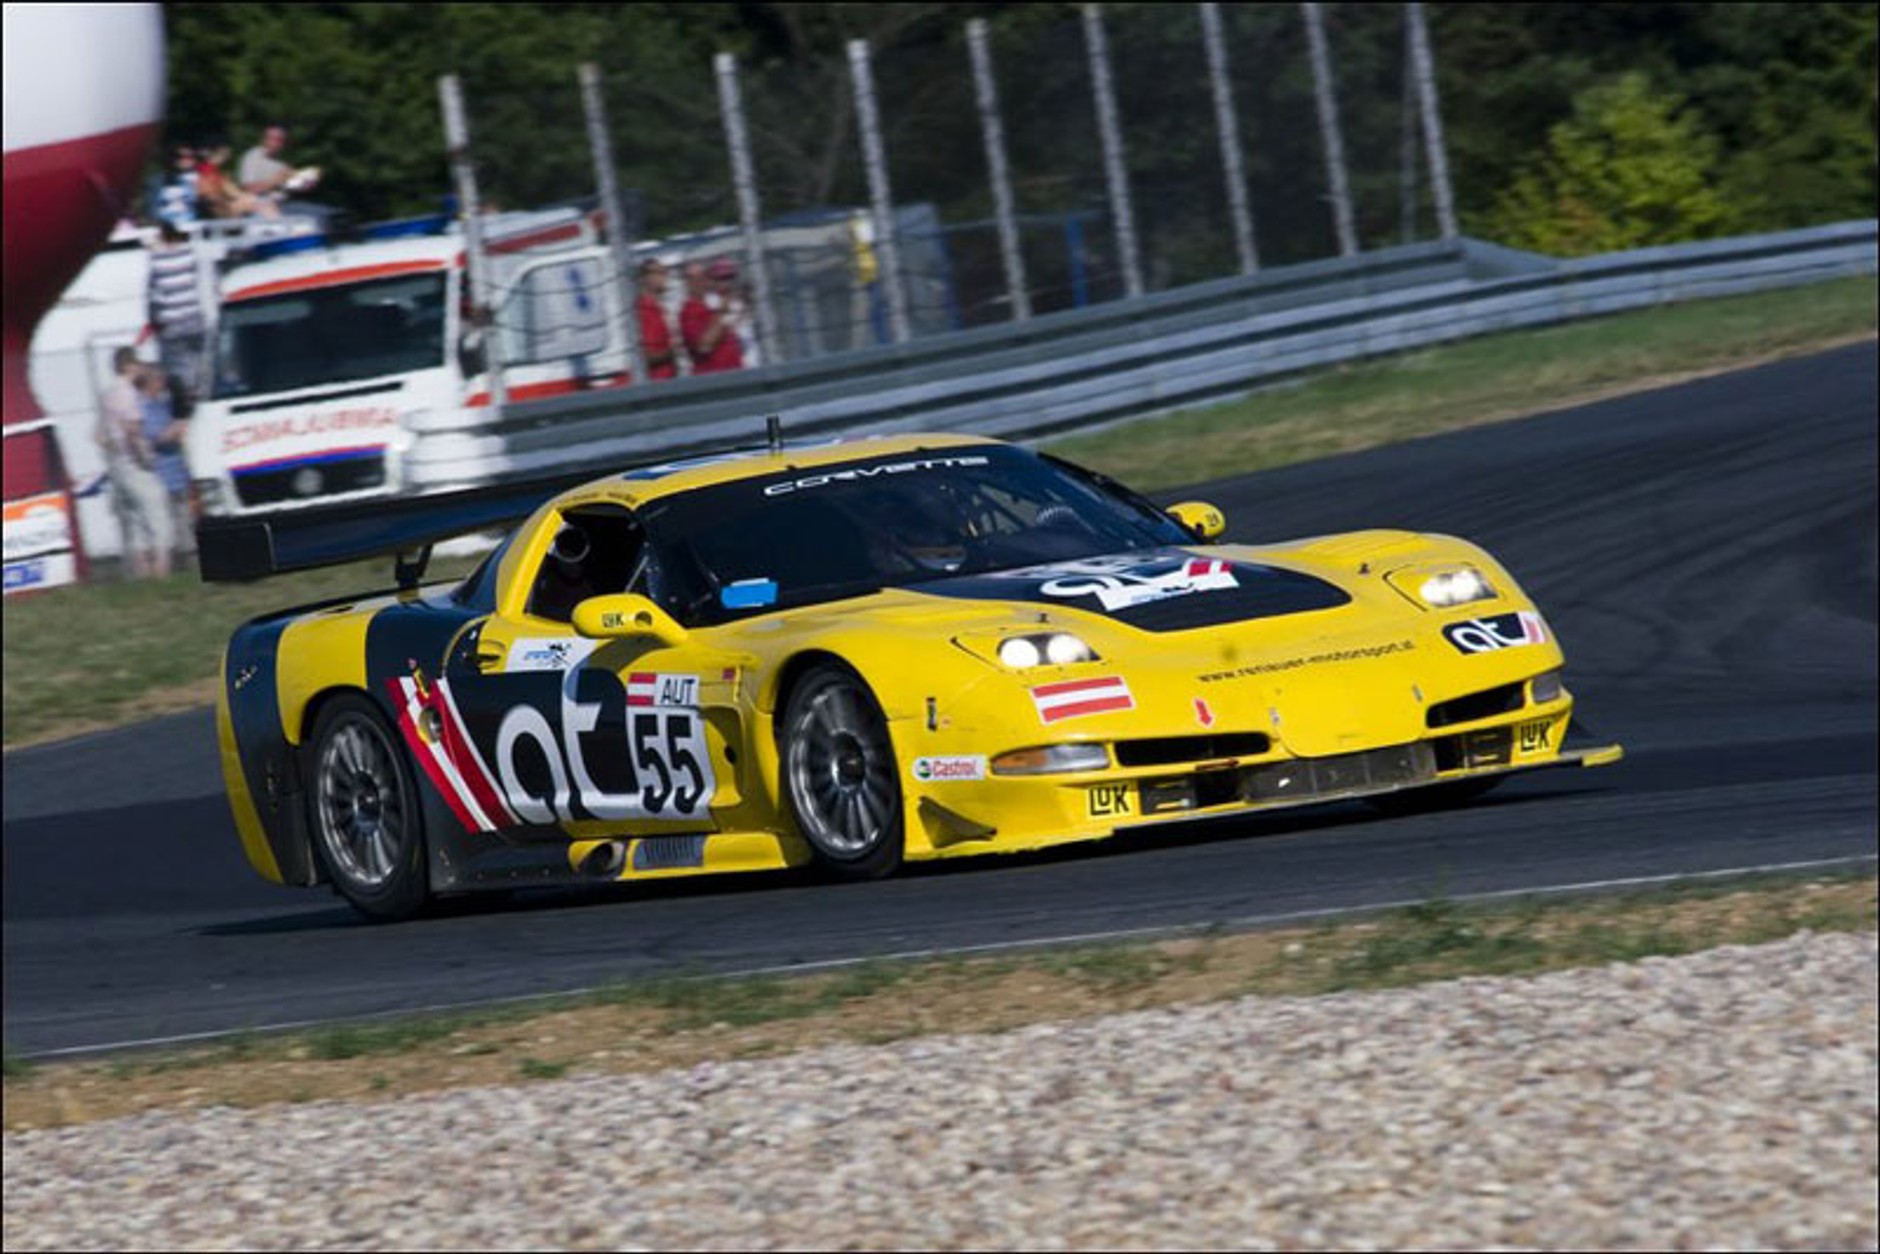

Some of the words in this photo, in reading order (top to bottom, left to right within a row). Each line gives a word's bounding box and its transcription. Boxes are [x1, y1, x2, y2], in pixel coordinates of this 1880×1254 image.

[763, 455, 989, 497] CORVETTE
[660, 678, 696, 705] AUT
[634, 713, 706, 815] 55
[931, 758, 977, 778] Castrol
